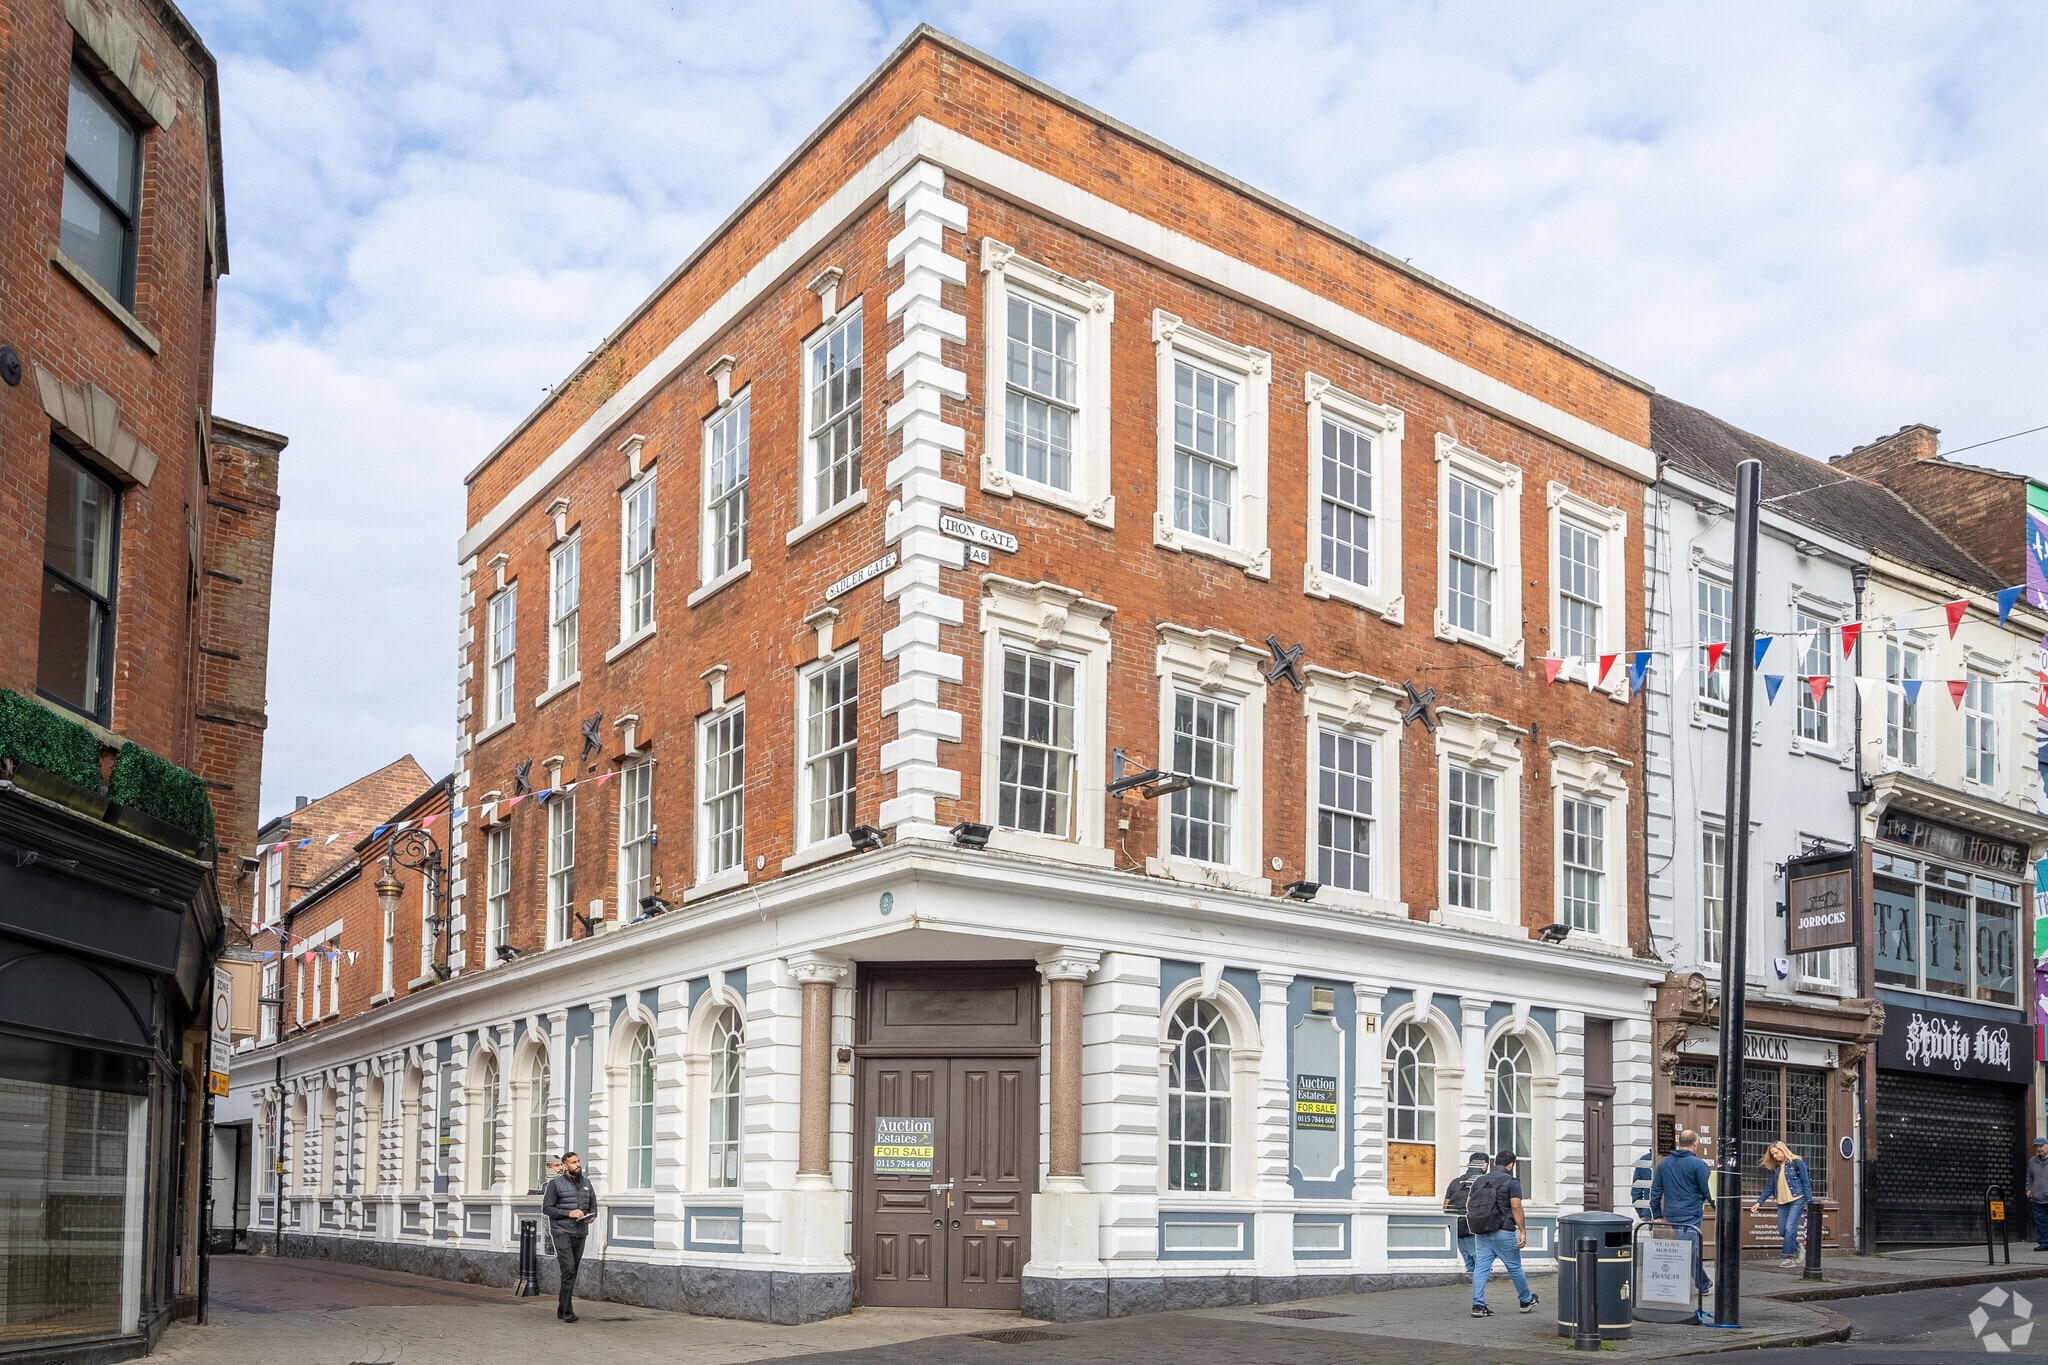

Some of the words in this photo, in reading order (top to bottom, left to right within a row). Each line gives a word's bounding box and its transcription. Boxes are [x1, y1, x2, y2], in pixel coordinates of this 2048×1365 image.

[945, 518, 976, 537] IRON
[980, 530, 1014, 549] GATE
[972, 550, 988, 562] A6
[829, 570, 865, 598] SADLER
[867, 554, 892, 577] GATE
[1887, 819, 1907, 836] The
[1797, 911, 1846, 929] JORROCKS
[1873, 902, 2014, 978] TATTOO
[217, 979, 229, 993] ZONE
[1744, 1034, 1788, 1060] RROCKS
[1906, 1013, 1971, 1071] Studio
[1973, 1025, 2011, 1072] One
[1298, 1076, 1335, 1090] Auction
[1298, 1090, 1325, 1100] Estates
[1298, 1103, 1313, 1112] FOR
[1315, 1104, 1335, 1113] SALE
[878, 1118, 931, 1132] Auction
[877, 1133, 917, 1144] Estates
[876, 1147, 899, 1156] FOR
[902, 1147, 931, 1157] SALE
[876, 1159, 895, 1168] 0115
[896, 1160, 915, 1168] 7844
[916, 1160, 931, 1168] 600
